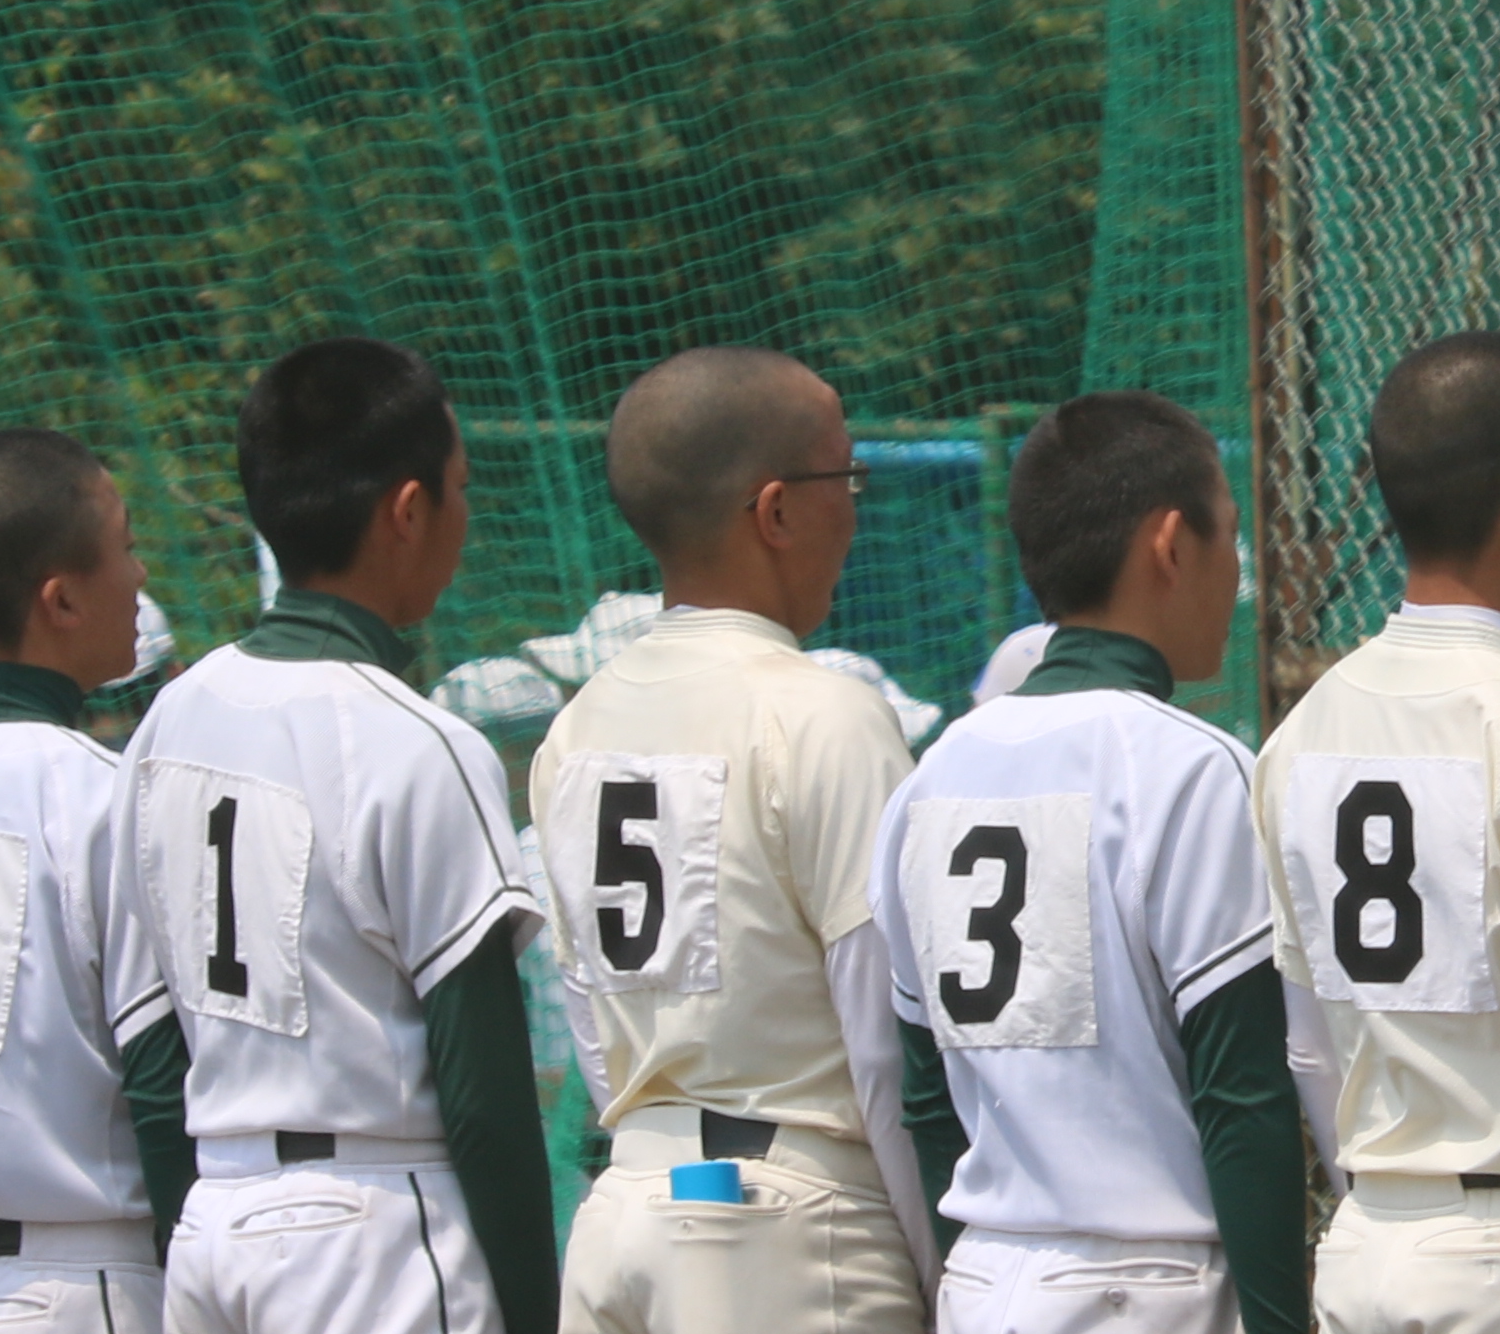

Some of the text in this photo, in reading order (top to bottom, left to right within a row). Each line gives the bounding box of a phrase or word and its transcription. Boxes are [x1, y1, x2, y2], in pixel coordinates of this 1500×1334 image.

[207, 795, 248, 998] 1
[593, 781, 666, 972] 5
[939, 825, 1028, 1025] 3
[1332, 780, 1424, 984] 8
